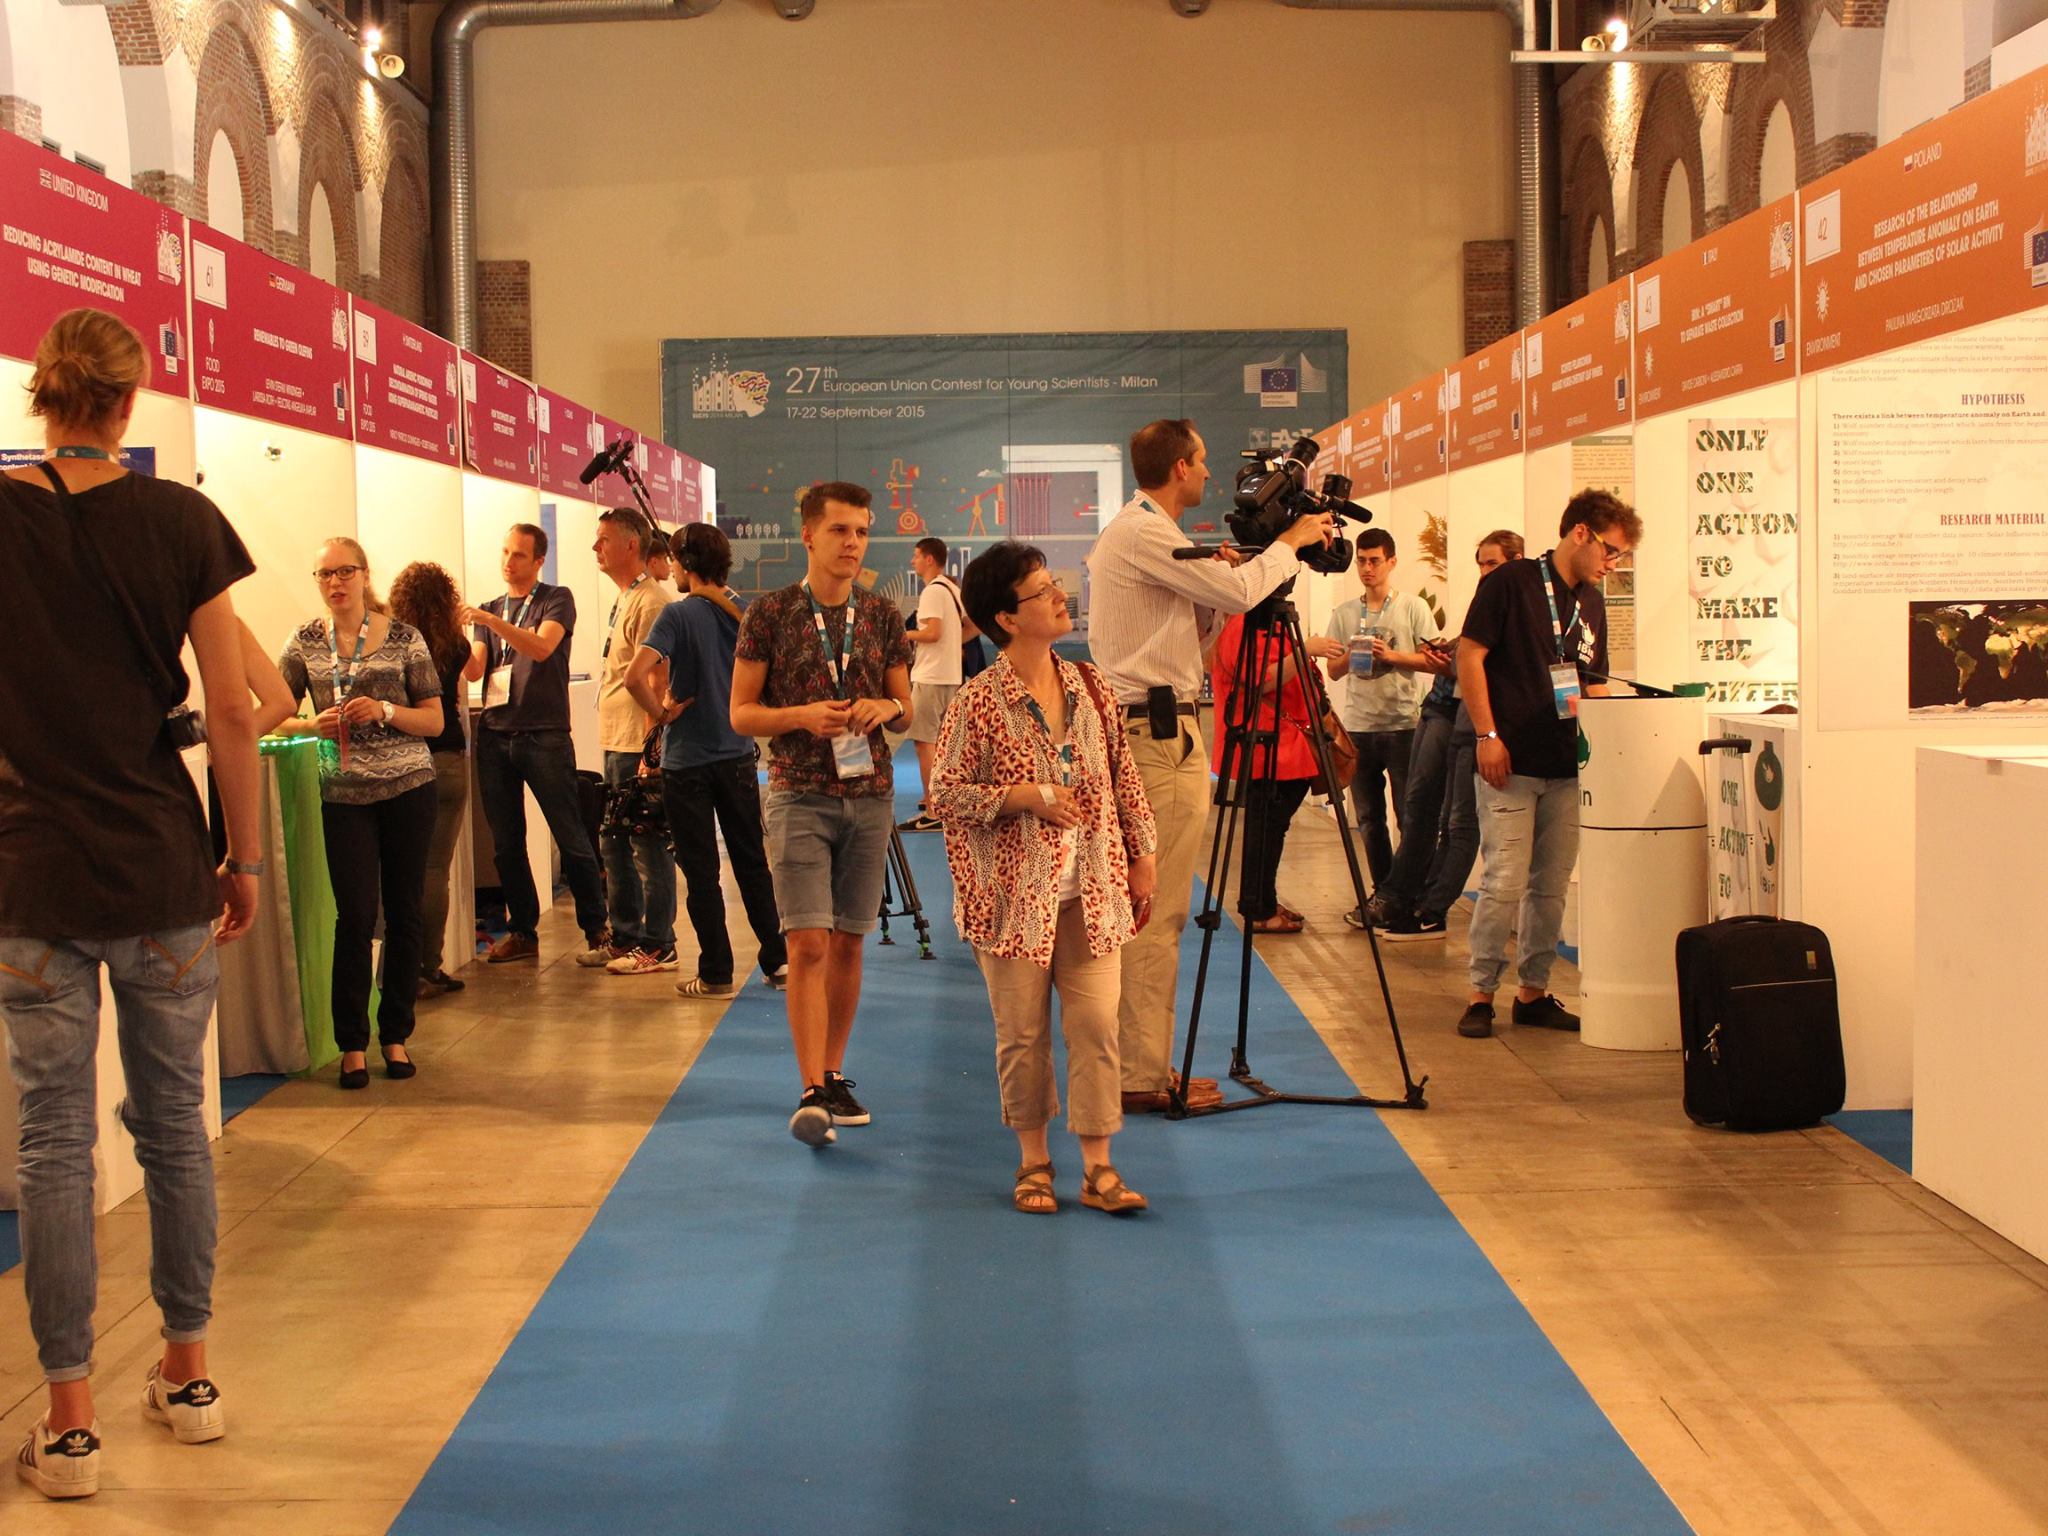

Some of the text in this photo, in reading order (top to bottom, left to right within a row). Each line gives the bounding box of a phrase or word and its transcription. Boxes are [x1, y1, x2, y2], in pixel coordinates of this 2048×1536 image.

[1912, 142, 1941, 168] POLAND
[52, 174, 108, 212] UNITED KINGDOM
[1874, 182, 1978, 238] RESEARCH OF THE RELATIONSHIP
[1858, 199, 1998, 268] BETWEEN TEMPERATURE ANOMALY ON EARTH
[3, 224, 141, 286] REDUCING ACRYLAMIDE CONTENT IN WHEAT
[1854, 223, 2004, 292] AND CHOSEN PARAMETERS OF SOLAR ACTIVITY
[28, 257, 125, 303] USING GENETIC MODIFICATION
[205, 357, 220, 373] FOOD
[201, 376, 214, 392] EXPO
[823, 379, 888, 395] European
[890, 378, 929, 393] Union
[931, 377, 990, 392] Contest
[992, 377, 1005, 391] for
[1006, 377, 1048, 393] Young
[1051, 375, 1110, 390] Scientists
[1121, 375, 1158, 389] Milan
[1961, 394, 2025, 405] HYPOTHESIS
[786, 405, 925, 421] 17-22 September 2015
[1696, 429, 1768, 452] ONLY
[1696, 472, 1753, 494] ONE
[1696, 513, 1798, 536] ACTION
[1940, 514, 2046, 525] RESEARCH MATERIAL
[1697, 555, 1733, 577] TO
[1697, 597, 1778, 619] MAKE
[1697, 640, 1752, 662] THE
[1721, 778, 1739, 807] ONE
[1719, 826, 1748, 857] ACTIO
[1718, 873, 1731, 899] TO
